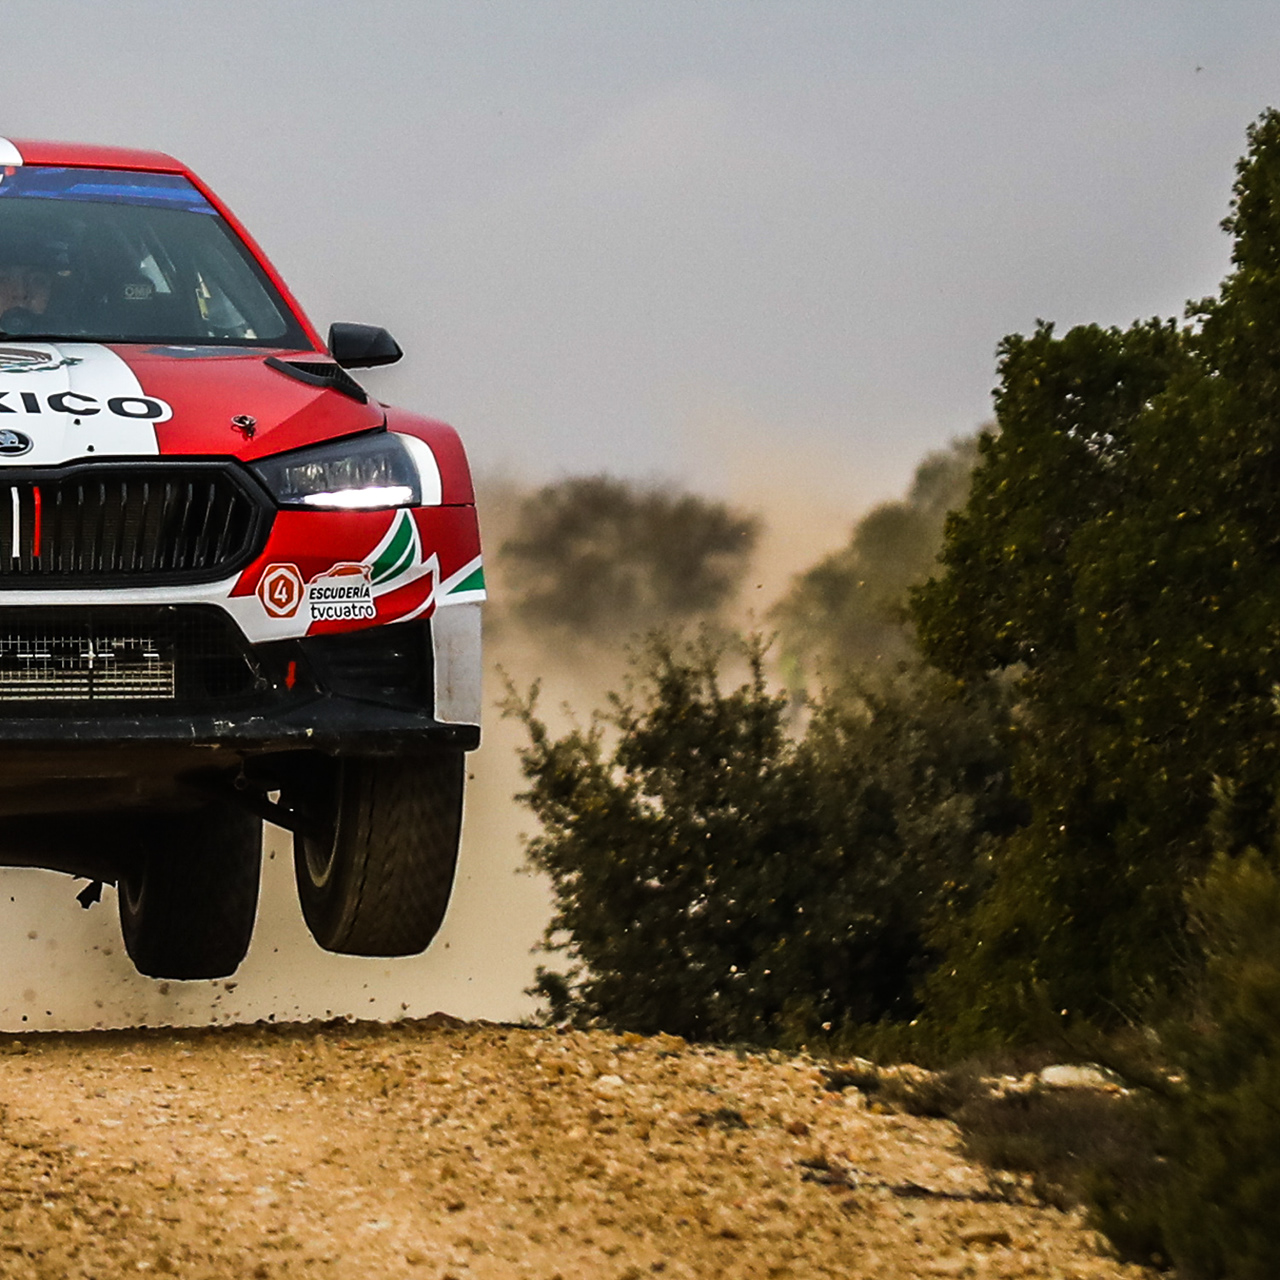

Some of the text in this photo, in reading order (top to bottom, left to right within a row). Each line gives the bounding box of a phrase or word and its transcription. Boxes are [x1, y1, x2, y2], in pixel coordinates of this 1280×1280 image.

[273, 579, 288, 603] 4
[309, 584, 371, 600] ESCUDERÍA
[310, 603, 374, 619] tvcuatro
